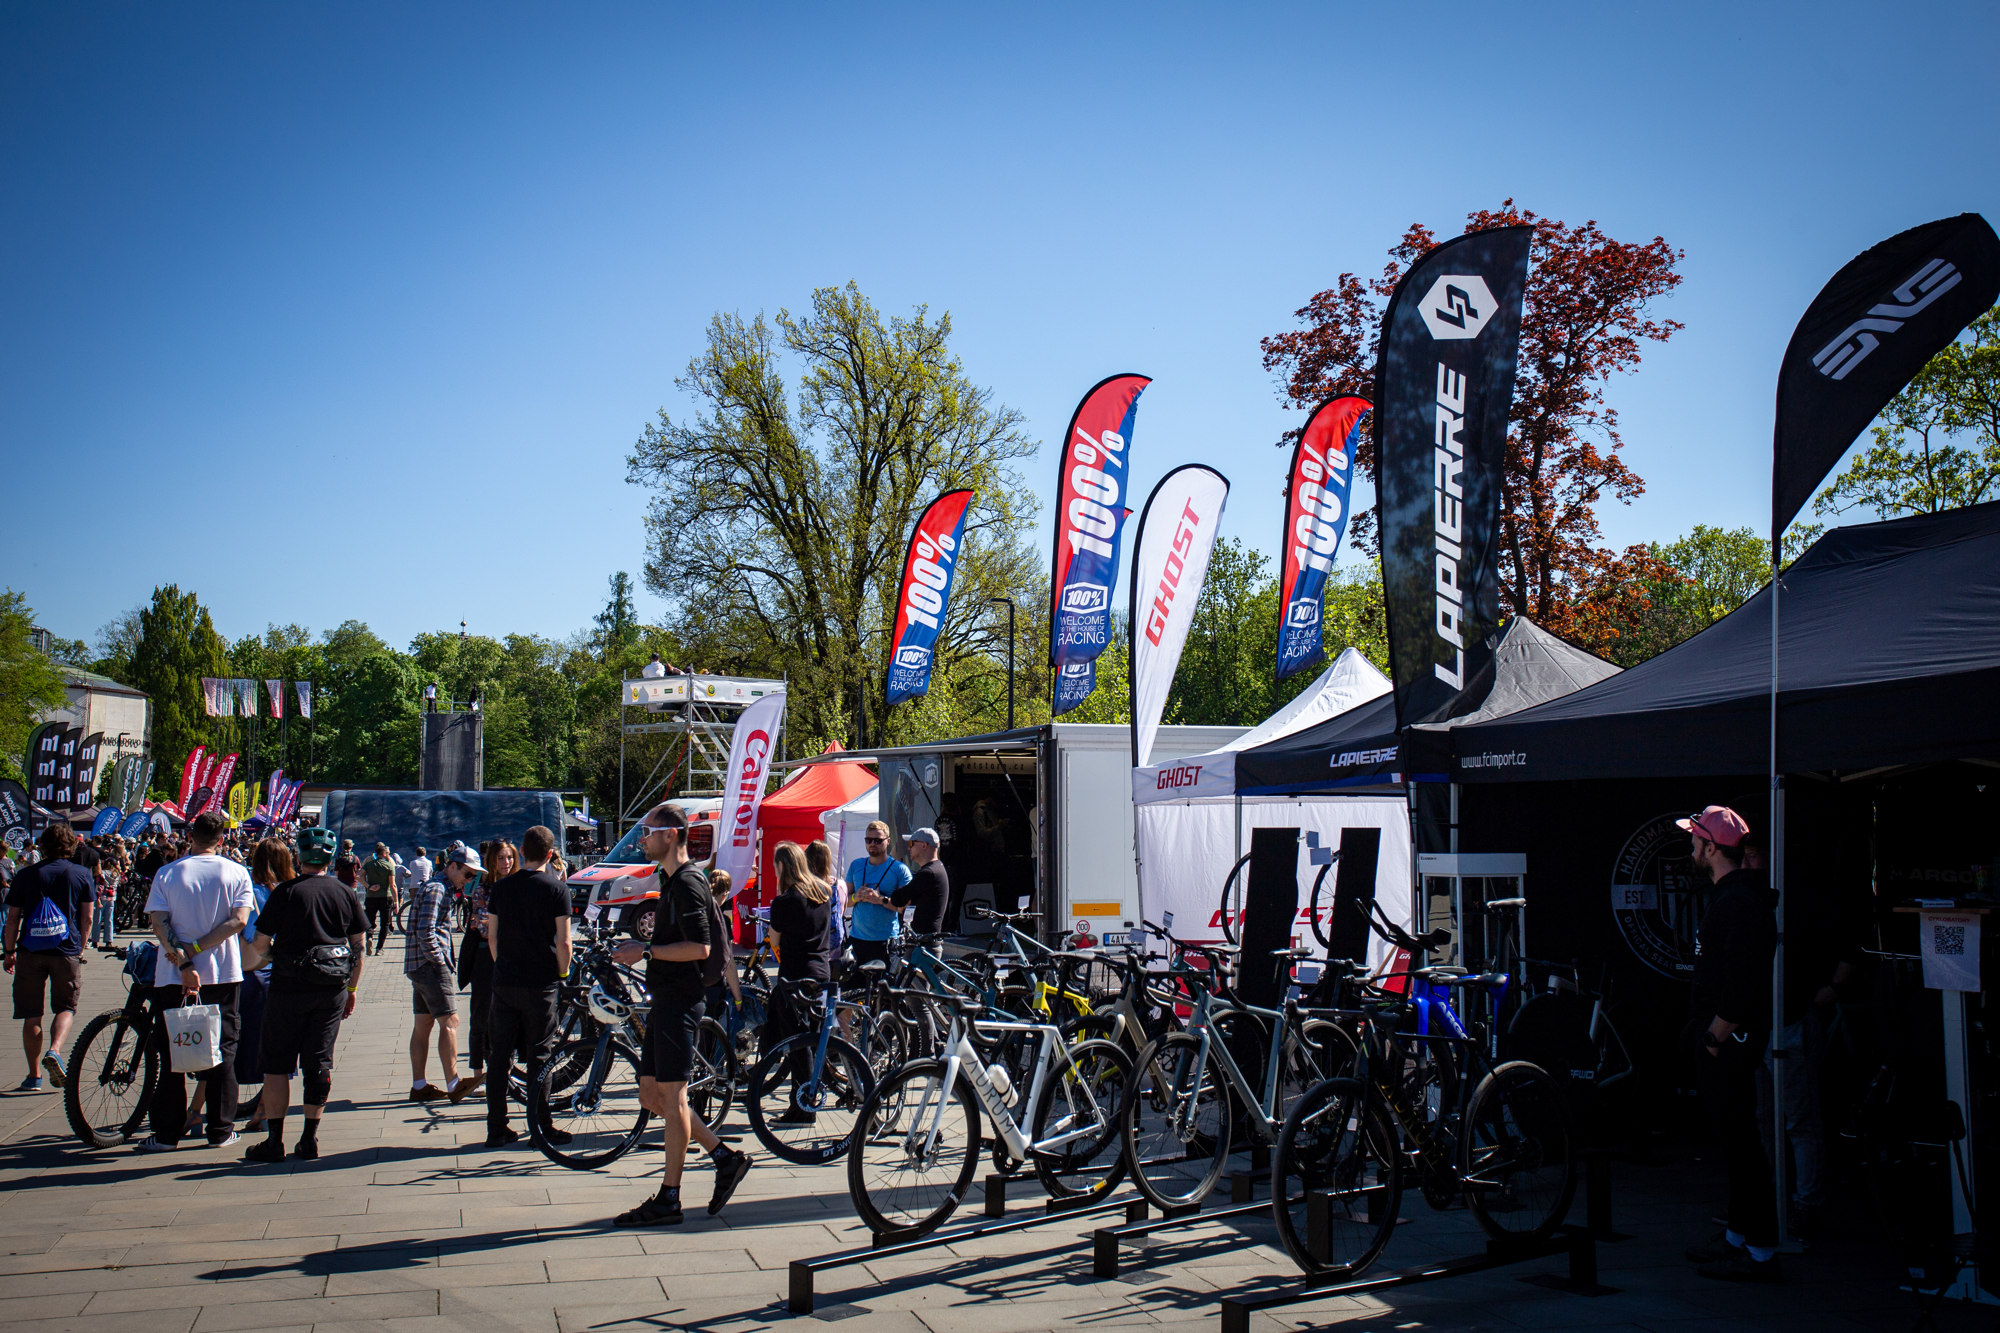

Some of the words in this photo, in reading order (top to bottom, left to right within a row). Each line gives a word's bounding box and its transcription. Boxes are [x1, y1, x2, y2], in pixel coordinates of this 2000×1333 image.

[1067, 426, 1124, 559] 100%
[1294, 442, 1348, 574] 100%
[1434, 362, 1466, 692] LAPIERRE
[905, 528, 956, 630] 100%
[1145, 496, 1200, 648] GHOST
[1066, 590, 1103, 607] 100%
[1060, 616, 1106, 626] WELCOME
[1058, 632, 1106, 646] RACING
[901, 650, 928, 664] 100%
[42, 735, 59, 752] n1
[63, 740, 75, 756] n1
[82, 744, 96, 760] n1
[1329, 745, 1400, 768] LAPIERRE
[1461, 751, 1527, 771] www.fcimport.cz
[39, 759, 56, 776] n1
[60, 763, 72, 779] n1
[80, 766, 93, 782] n1
[133, 760, 142, 792] RCO
[121, 757, 135, 816] NORCO
[1156, 765, 1203, 790] GHOST
[36, 784, 54, 800] n1
[57, 786, 71, 803] n1
[77, 789, 91, 805] n1
[733, 729, 770, 848] Canon
[100, 811, 118, 835] OVAKIA
[1619, 819, 1672, 875] HANDMAD
[1111, 935, 1125, 945] 4AY
[173, 1030, 203, 1047] 420
[965, 1059, 1016, 1135] AURUM
[822, 1148, 835, 1158] DT
[836, 1135, 852, 1152] SWI
